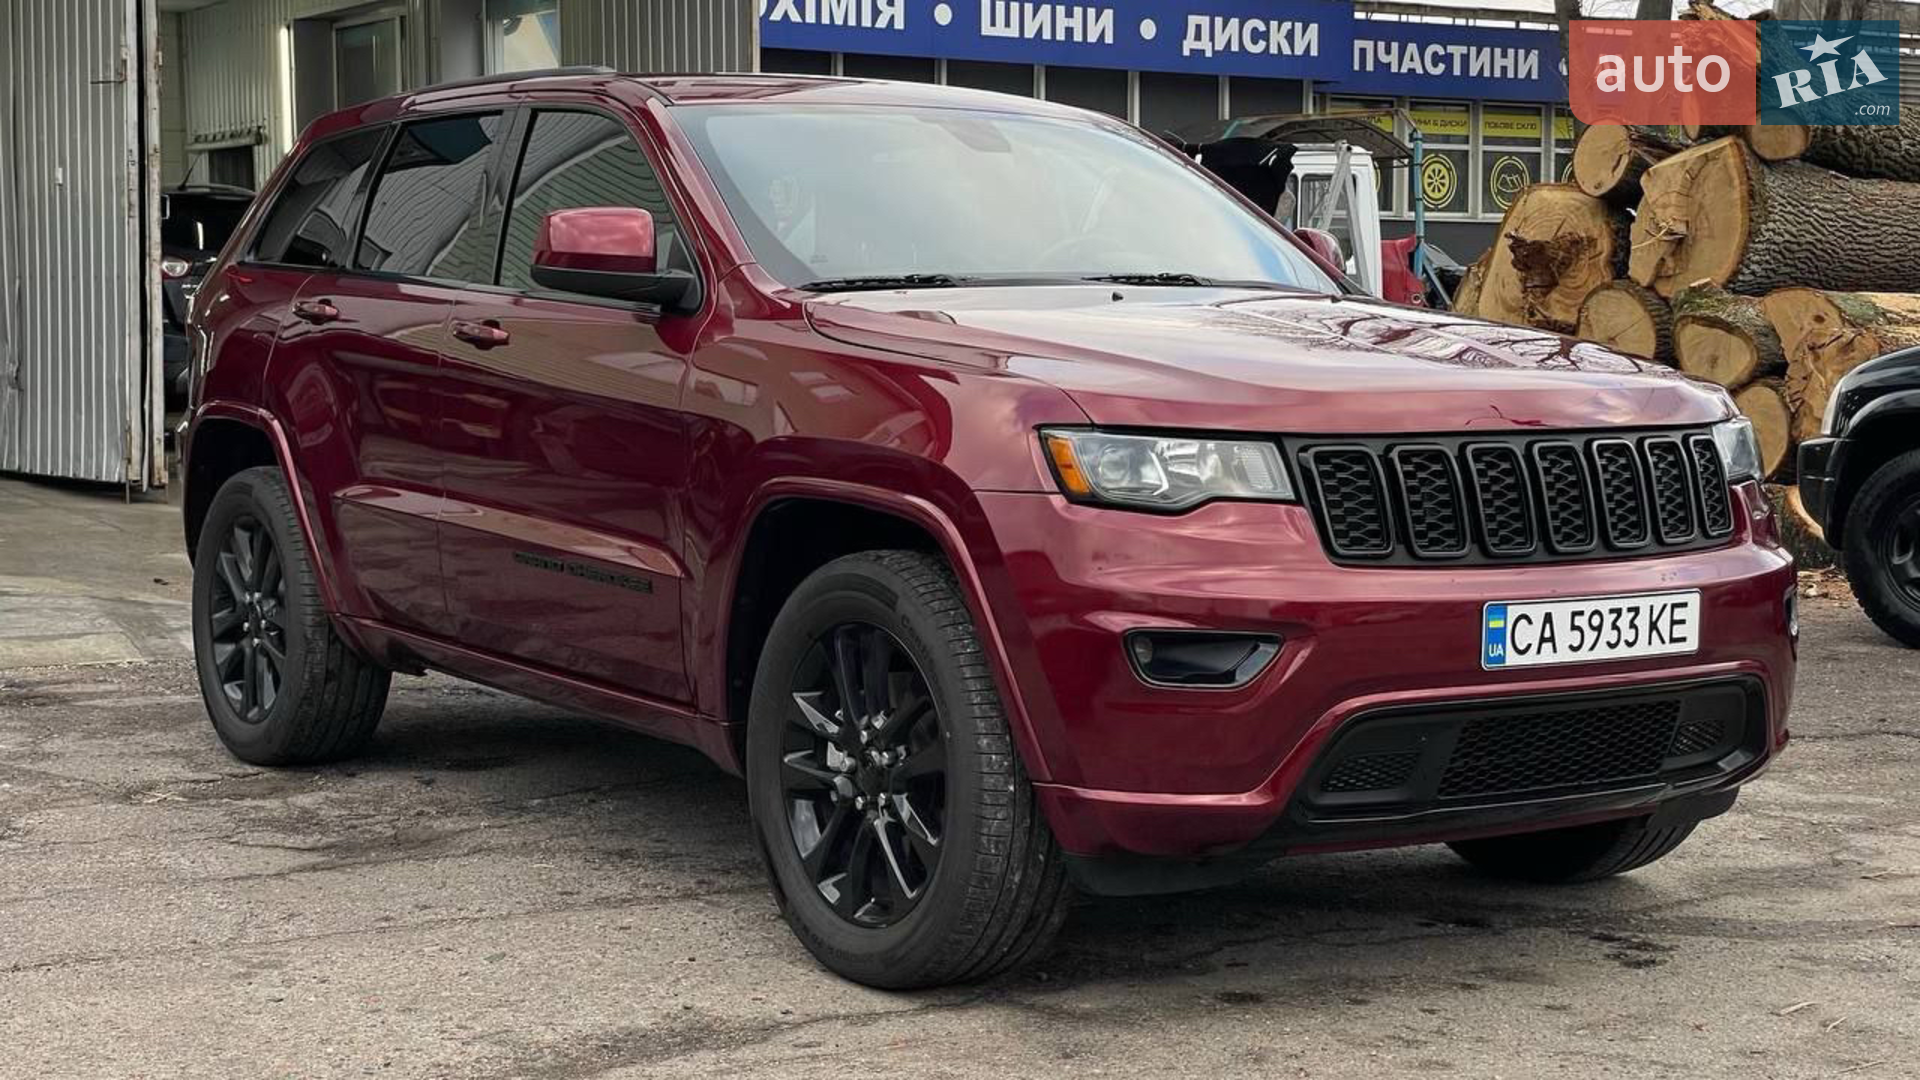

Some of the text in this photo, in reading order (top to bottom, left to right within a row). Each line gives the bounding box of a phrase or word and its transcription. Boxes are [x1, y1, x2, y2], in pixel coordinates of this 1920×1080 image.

[759, 0, 1319, 57] ХІМІЯ ШИНИ ДИСКИ
[1489, 643, 1504, 657] UA
[1511, 601, 1688, 656] CA 5933 KE
